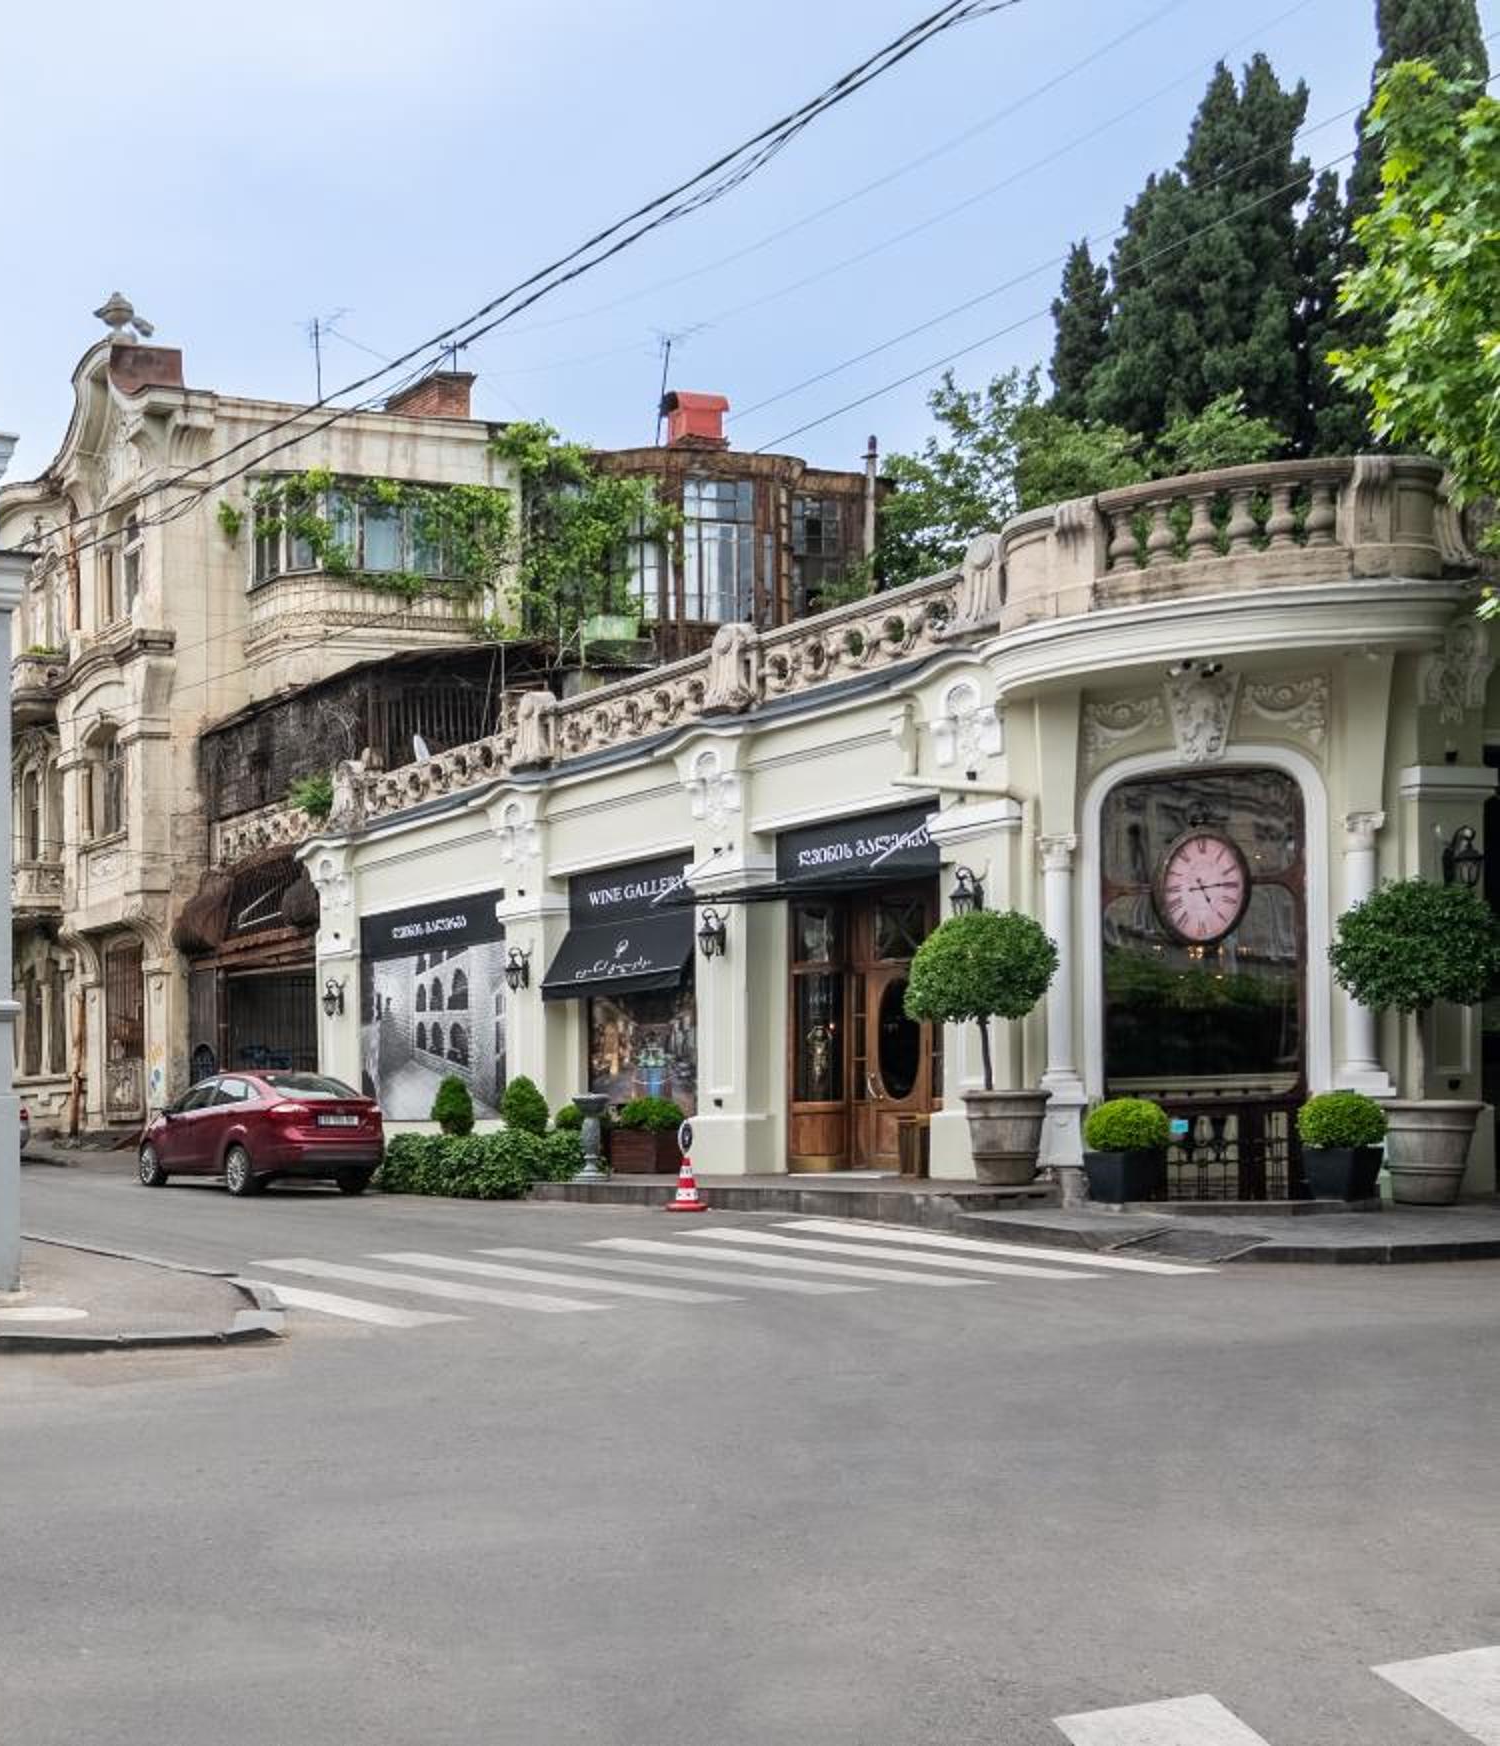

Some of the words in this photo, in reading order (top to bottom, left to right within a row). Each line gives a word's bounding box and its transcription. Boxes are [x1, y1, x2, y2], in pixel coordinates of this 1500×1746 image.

[798, 843, 853, 867] ღვინის
[588, 887, 622, 907] WINE
[623, 875, 684, 899] GALLERY
